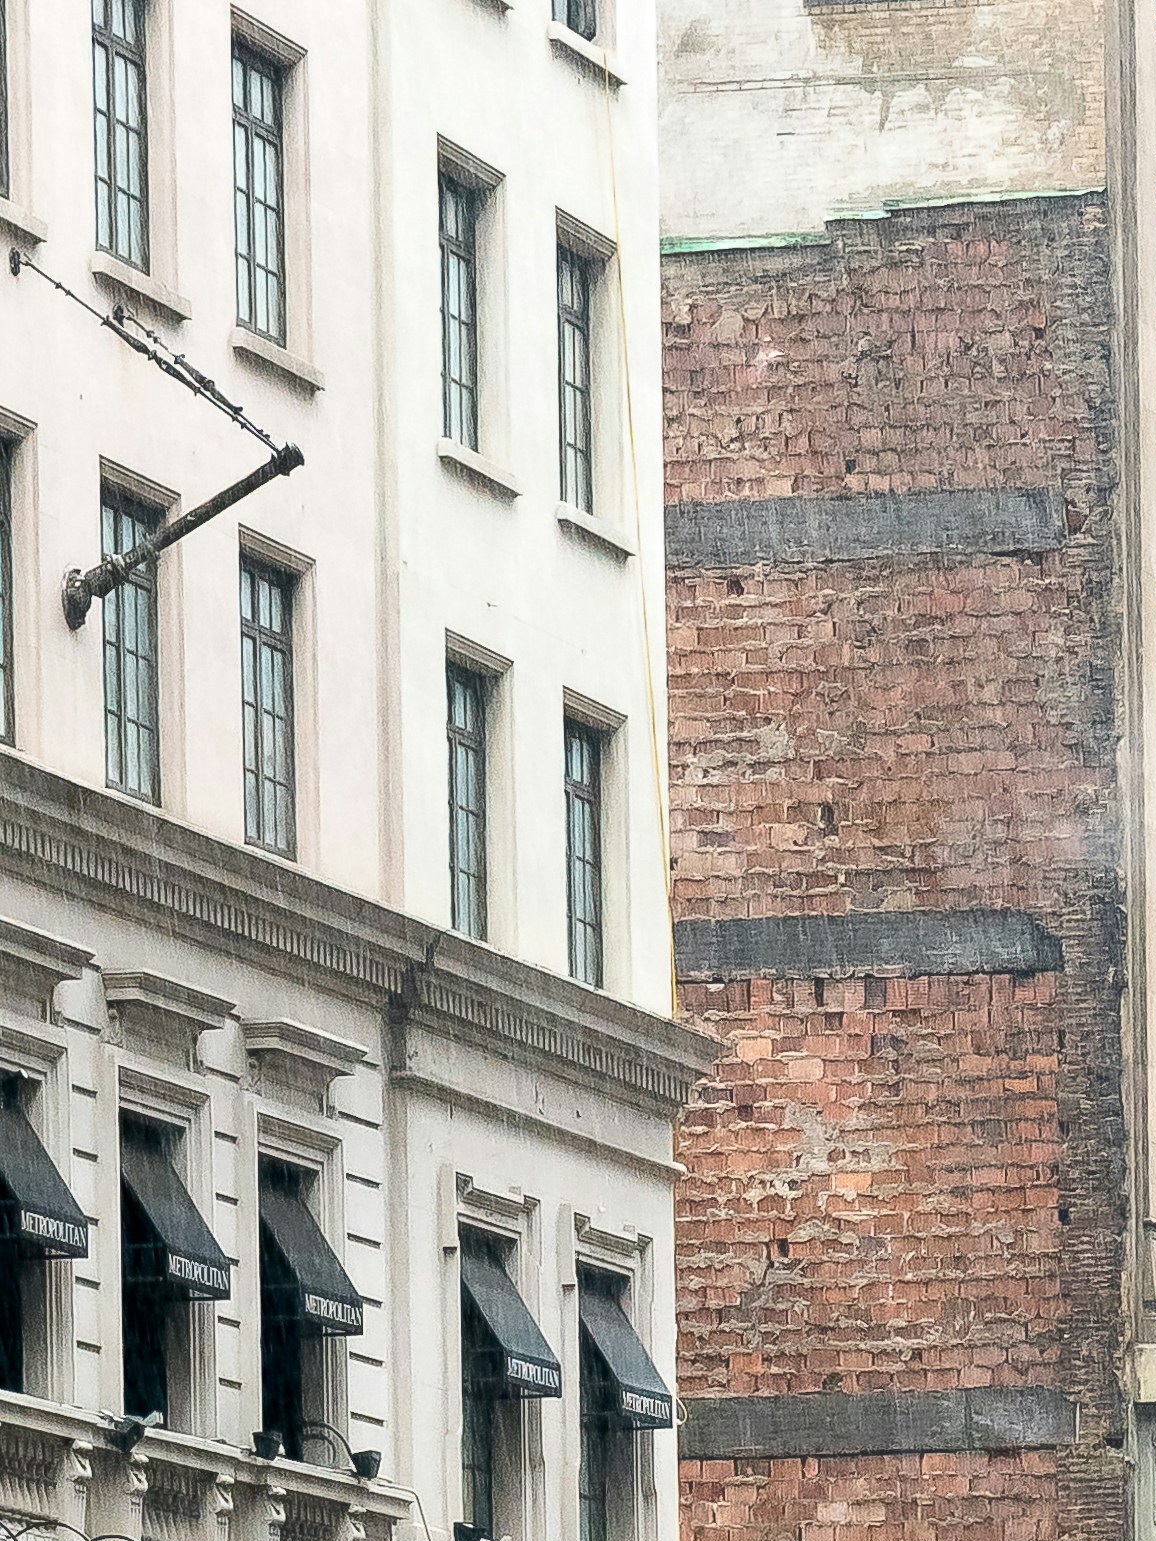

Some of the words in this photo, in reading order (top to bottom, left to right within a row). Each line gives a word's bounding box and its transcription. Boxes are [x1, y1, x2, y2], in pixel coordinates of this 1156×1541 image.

[20, 1210, 87, 1249] METROPOLITAN
[168, 1253, 229, 1290] METROPOLITAN
[304, 1293, 362, 1326] METROPOLITAN
[507, 1356, 559, 1389] METROPOLITAN
[622, 1391, 671, 1420] METROPOLITAN
